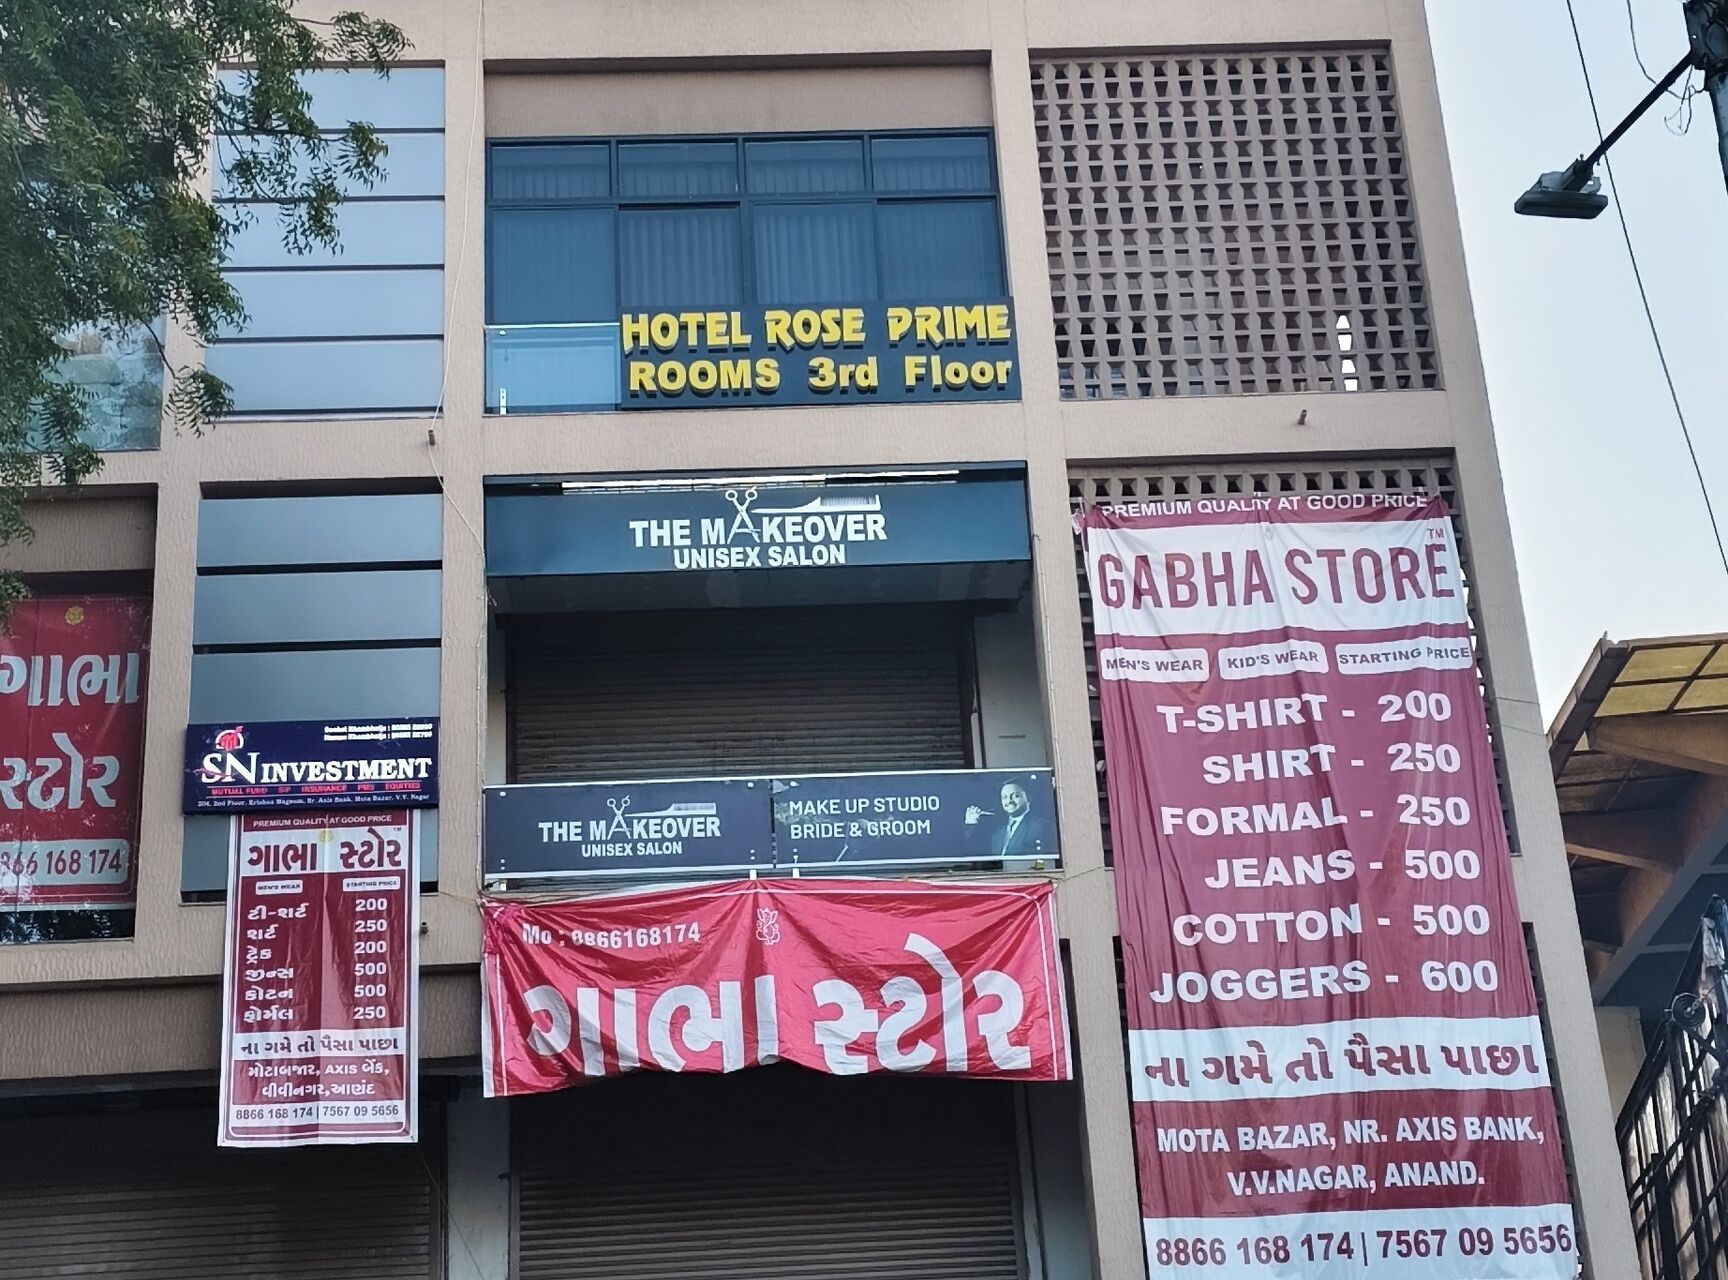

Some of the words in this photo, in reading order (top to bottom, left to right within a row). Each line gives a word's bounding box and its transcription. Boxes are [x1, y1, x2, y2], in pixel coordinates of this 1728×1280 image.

[622, 311, 751, 354] HOTEL
[765, 308, 866, 349] ROSE
[887, 305, 1010, 348] PRIME
[629, 358, 780, 394] ROOMS
[809, 356, 878, 391] 3rd
[905, 355, 1012, 389] Floor
[1102, 502, 1192, 518] PREMIUM
[1278, 497, 1302, 510] AT
[1307, 495, 1366, 509] GOOD
[1371, 494, 1427, 508] PRICE
[629, 519, 691, 547] THE
[702, 499, 887, 546] MAKEOVER
[1427, 528, 1444, 539] TM
[674, 546, 762, 569] UNISEX
[767, 543, 845, 566] SALON
[1098, 550, 1274, 610] GABHA
[1284, 544, 1455, 604] STORE
[1106, 657, 1151, 671] MEN'S
[1155, 659, 1203, 672] WEAR
[1228, 652, 1270, 669] KID'S
[1275, 650, 1319, 664] WEAR
[1339, 648, 1422, 665] STARTING
[1427, 647, 1470, 659] PRICE
[1156, 693, 1328, 734] T-SHIRT
[1378, 690, 1451, 722] 200
[201, 752, 260, 784] SN
[260, 757, 432, 784] INVESTMENT
[1202, 744, 1336, 785] SHIRT
[1387, 742, 1460, 773] 250
[789, 798, 841, 816] MAKE
[845, 798, 870, 815] UP
[874, 796, 940, 813] STUDIO
[1160, 796, 1348, 836] FORMAL
[1397, 794, 1470, 826] 250
[253, 819, 291, 827] PREMIUM
[538, 819, 582, 844] THE
[589, 806, 722, 841] MAKEOVER
[790, 822, 847, 840] BRIDE
[850, 822, 863, 838] &
[867, 819, 931, 838] GROOM
[46, 850, 81, 874] 168
[89, 849, 121, 874] 174
[247, 843, 317, 872] ગાભા
[340, 828, 402, 868] સ્ટોર
[581, 842, 633, 858] UNISEX
[636, 841, 683, 857] SALON
[1204, 849, 1355, 889] JEANS
[1405, 849, 1481, 880] 500
[355, 898, 387, 911] 200
[355, 919, 387, 932] 250
[1173, 903, 1362, 946] COTTON
[1413, 904, 1490, 935] 500
[354, 941, 387, 954] 200
[355, 963, 386, 975] 500
[1150, 960, 1370, 1003] JOGGERS
[1421, 959, 1498, 993] 600
[354, 984, 386, 997] 500
[353, 1006, 386, 1019] 250
[525, 973, 779, 1076] ગાભા
[813, 933, 1032, 1076] સ્ટોર
[240, 1042, 259, 1055] ના
[264, 1037, 291, 1053] ગમે
[298, 1035, 315, 1052] તો
[320, 1035, 354, 1051] પૈસા
[360, 1038, 398, 1050] પાછા
[325, 1064, 357, 1074] AXIS
[1144, 1055, 1189, 1088] ના
[1202, 1039, 1272, 1084] ગમે
[1286, 1036, 1334, 1083] તો
[1344, 1032, 1430, 1078] પૈસા
[1440, 1043, 1539, 1077] પાછા
[236, 1109, 264, 1120] 8866
[268, 1109, 288, 1118] 168
[293, 1107, 312, 1117] 174
[323, 1106, 349, 1117] 7567
[354, 1106, 367, 1116] 09
[372, 1105, 399, 1116] 5656
[1157, 1125, 1230, 1153] MOTA
[1237, 1123, 1337, 1152] BAZAR,
[1343, 1119, 1387, 1143] NR.
[1396, 1116, 1458, 1142] AXIS
[1465, 1116, 1544, 1145] BANK,
[1227, 1164, 1376, 1196] V.V.NAGAR,
[1384, 1160, 1485, 1186] ANAND.
[1156, 1237, 1226, 1267] 8866
[1236, 1234, 1291, 1265] 168
[1300, 1232, 1353, 1263] 174
[1376, 1229, 1446, 1259] 7567
[1458, 1227, 1493, 1257] 09
[1503, 1224, 1572, 1255] 5656
